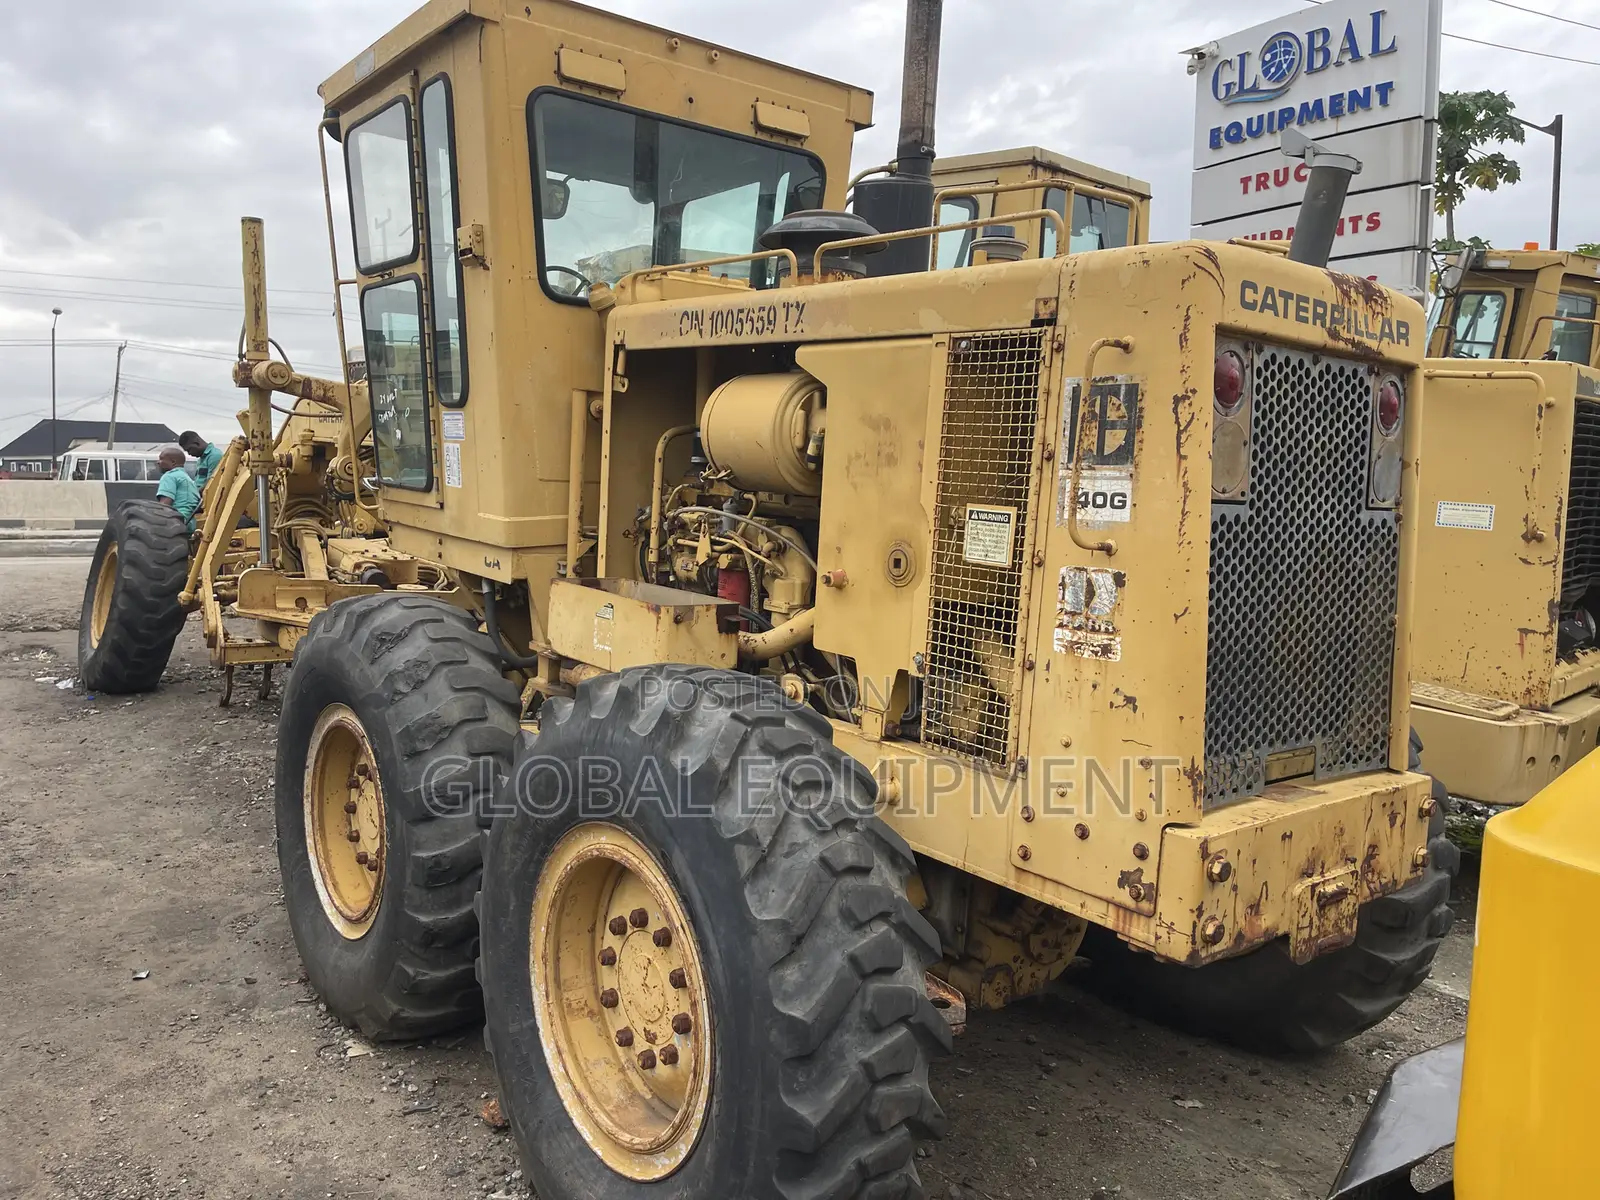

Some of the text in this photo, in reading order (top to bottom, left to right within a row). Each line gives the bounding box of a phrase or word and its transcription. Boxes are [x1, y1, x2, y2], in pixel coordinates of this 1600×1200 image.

[1211, 10, 1398, 103] GLOBAL
[1209, 81, 1394, 150] EQUIPMENT
[1240, 279, 1410, 347] CATERPILLAR
[978, 512, 1009, 523] WARNING
